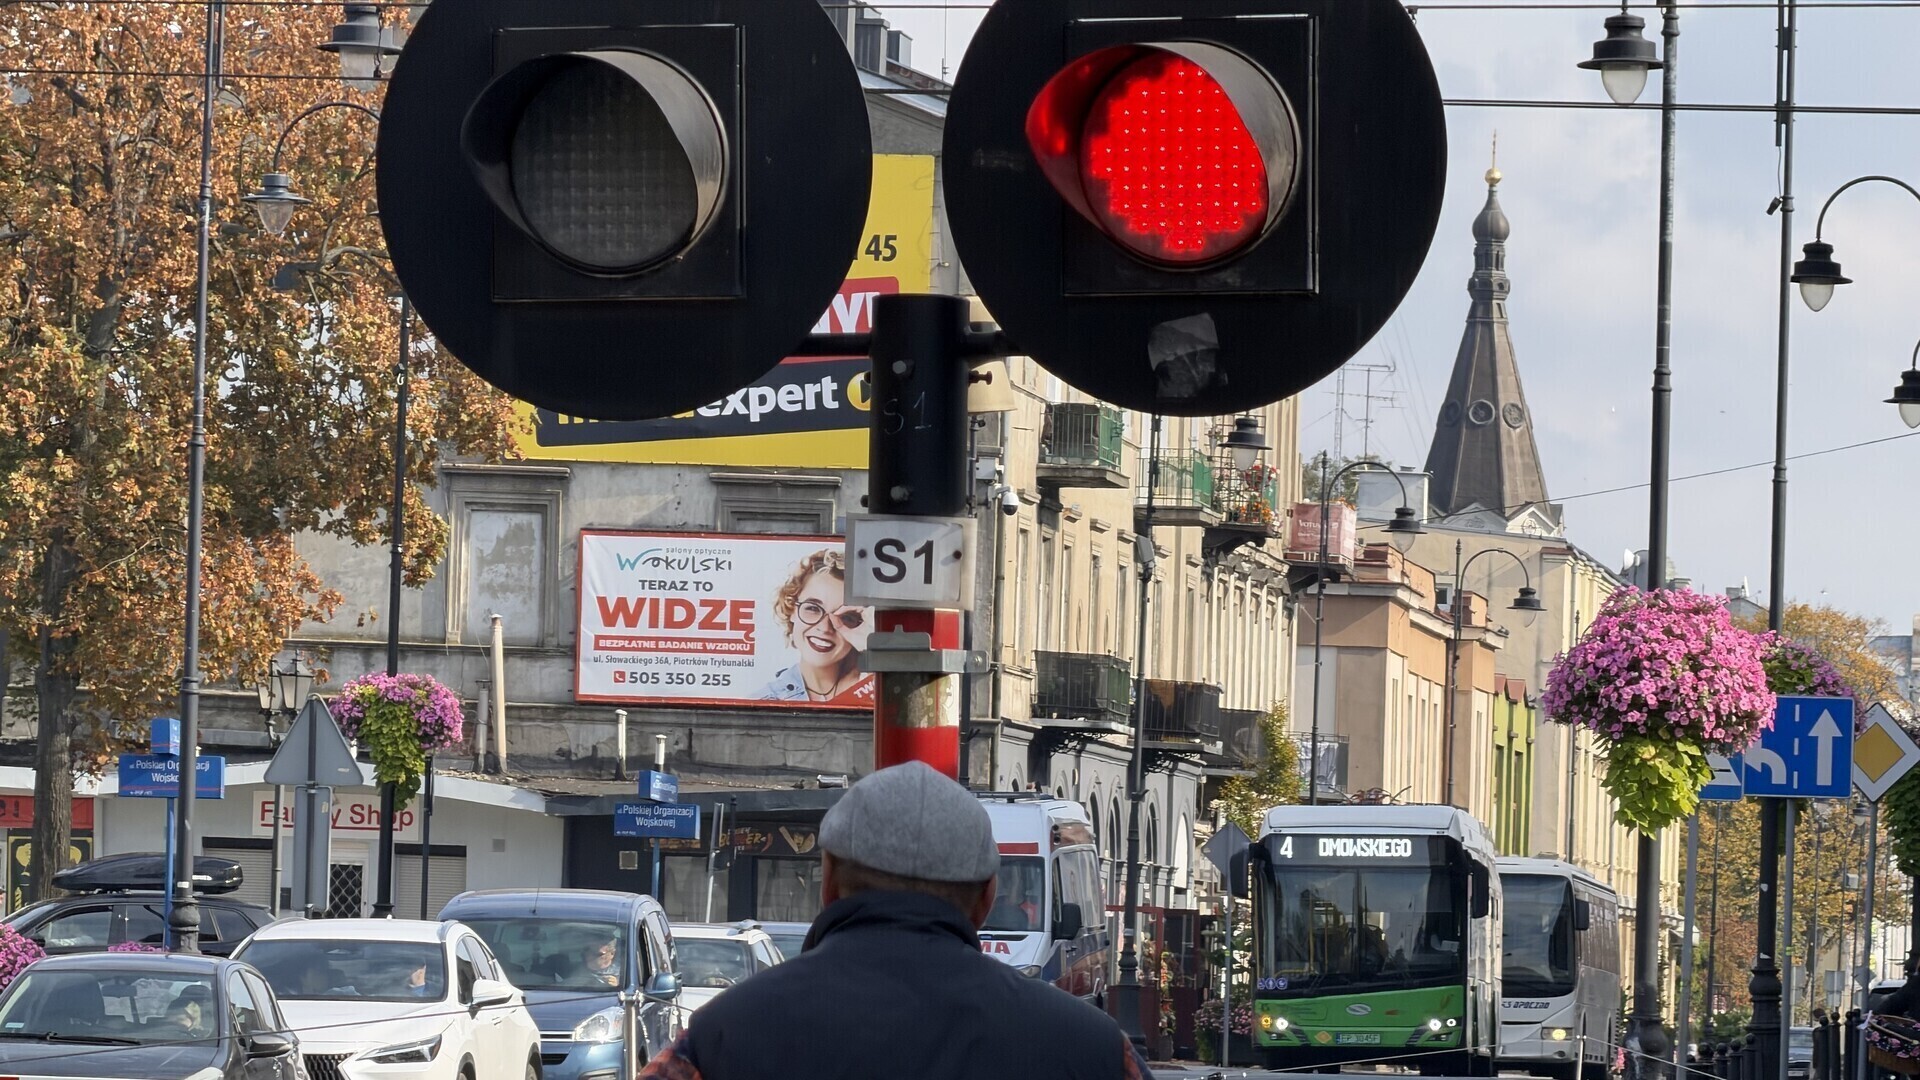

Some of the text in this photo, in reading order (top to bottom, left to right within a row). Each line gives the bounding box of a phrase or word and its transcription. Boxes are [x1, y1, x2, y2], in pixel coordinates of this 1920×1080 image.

[864, 234, 898, 262] 45
[1298, 519, 1321, 529] VOTU
[665, 547, 732, 556] salony optyczne
[871, 537, 935, 585] S1
[638, 579, 714, 592] TERAZ TO
[596, 596, 756, 642] WIDZĘ
[598, 639, 750, 651] BEZPŁATNE BADANIE WZROKU
[605, 655, 653, 667] Słowackiego
[673, 656, 708, 667] Piotrków
[710, 657, 755, 668] Trybunalski
[628, 671, 732, 687] 505 350 255
[853, 681, 876, 698] TW
[167, 760, 210, 771] Orgacji
[349, 803, 414, 832] Shp
[623, 805, 652, 816] Polskiej
[653, 806, 694, 817] Organizacji
[635, 817, 676, 828] Wojskowej
[1279, 836, 1412, 859] 4 DMOWSKIEGO
